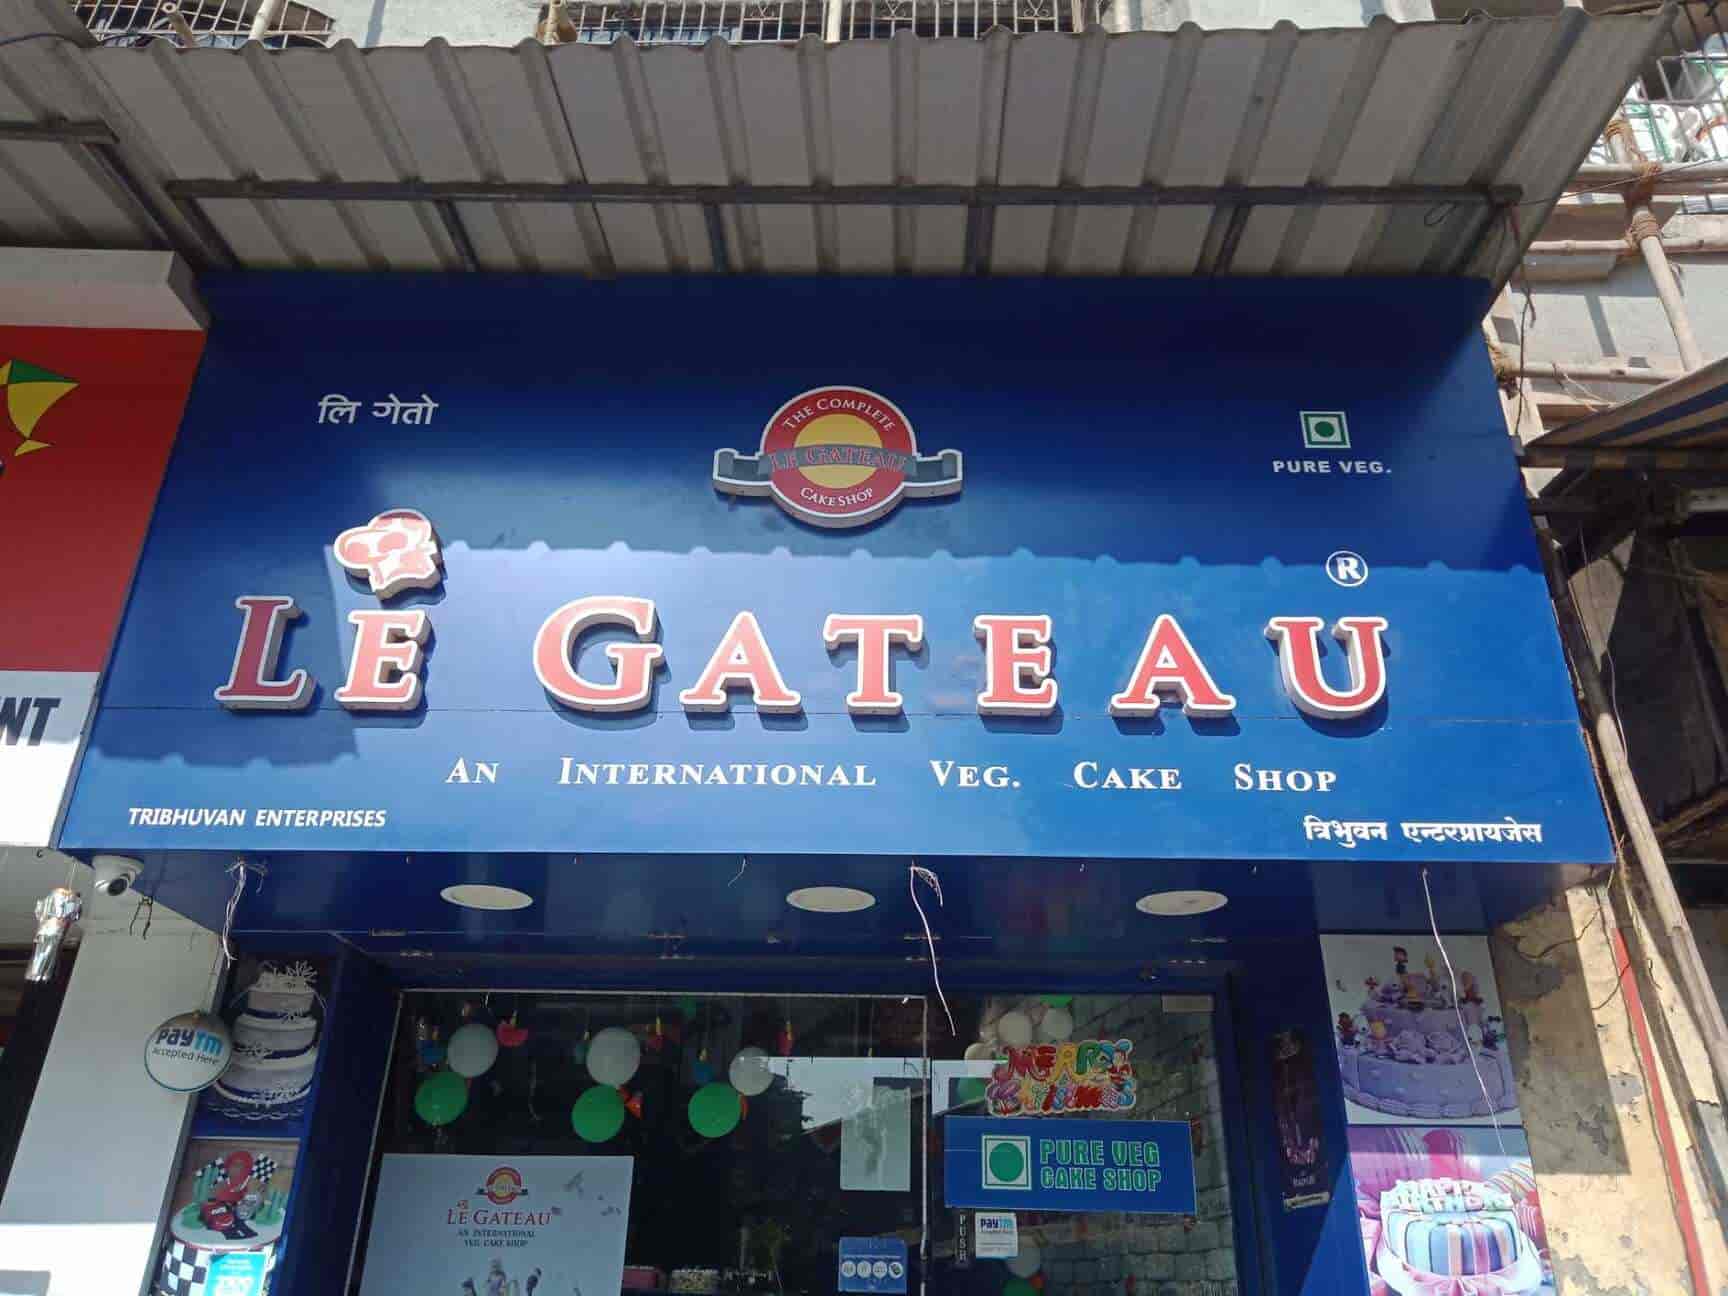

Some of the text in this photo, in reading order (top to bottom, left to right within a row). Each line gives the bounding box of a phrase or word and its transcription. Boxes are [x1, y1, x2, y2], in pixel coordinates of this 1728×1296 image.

[318, 393, 439, 425] लि गेतो
[783, 398, 896, 432] THE COMPLETE
[1272, 460, 1392, 475] PURE VEG.
[800, 487, 873, 506] CAKE SHOP
[215, 594, 432, 711] LE
[533, 594, 1389, 719] GATEAU
[445, 756, 1337, 792] AN INTERNATIONAL VEG. CAKE SHOP
[128, 807, 388, 828] TRIBHUVAN ENTERPRISES
[1304, 815, 1387, 848] त्रिभुवन
[1039, 1139, 1161, 1168] PURE VEG
[1040, 1166, 1162, 1192] CAKE SHOP
[447, 1208, 468, 1225] LE
[473, 1208, 552, 1226] GATEAU
